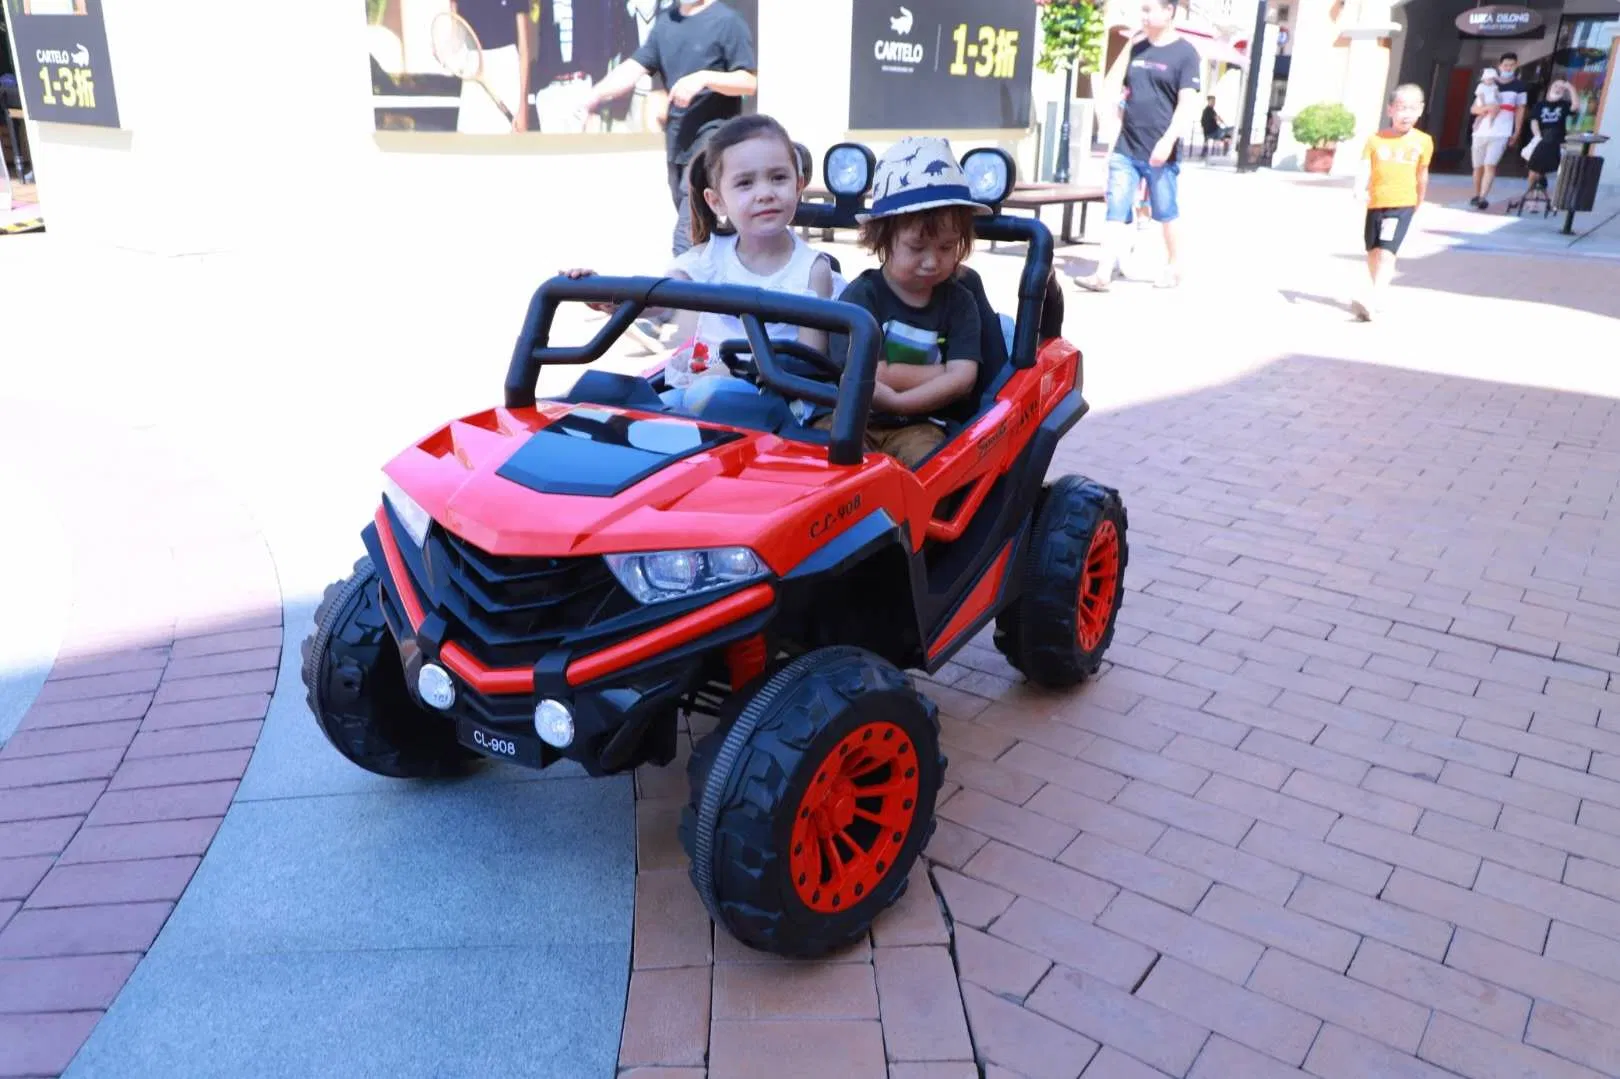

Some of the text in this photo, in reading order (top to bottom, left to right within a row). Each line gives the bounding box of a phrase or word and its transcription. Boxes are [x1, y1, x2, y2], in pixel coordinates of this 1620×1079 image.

[36, 48, 70, 64] CARTELO
[874, 39, 923, 63] CARTELO
[950, 23, 1019, 78] 1-3折
[39, 66, 96, 108] 1-3折
[473, 730, 516, 756] CL-908
